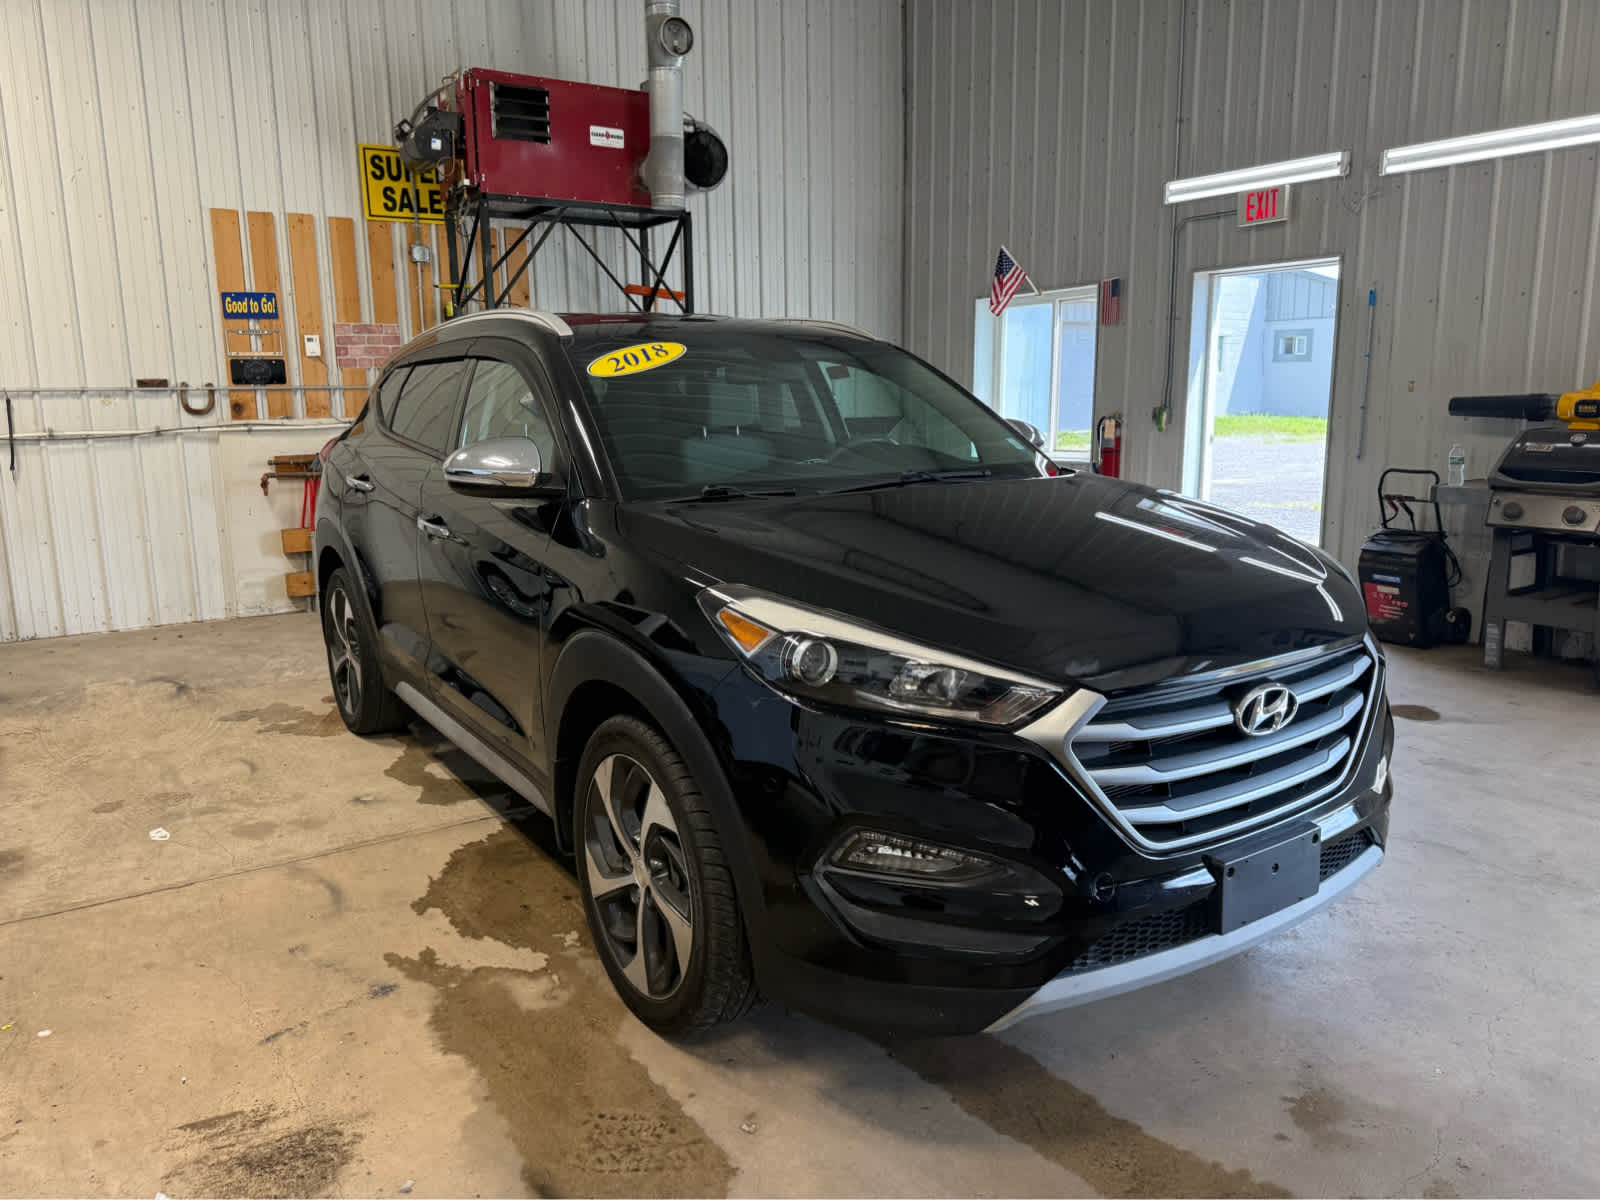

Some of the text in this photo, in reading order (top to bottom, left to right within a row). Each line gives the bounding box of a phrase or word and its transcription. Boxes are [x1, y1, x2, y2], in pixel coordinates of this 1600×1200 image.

[383, 186, 443, 215] SALE
[1246, 188, 1280, 222] EXIT
[225, 296, 276, 314] Good to Go!
[608, 344, 669, 373] 2018
